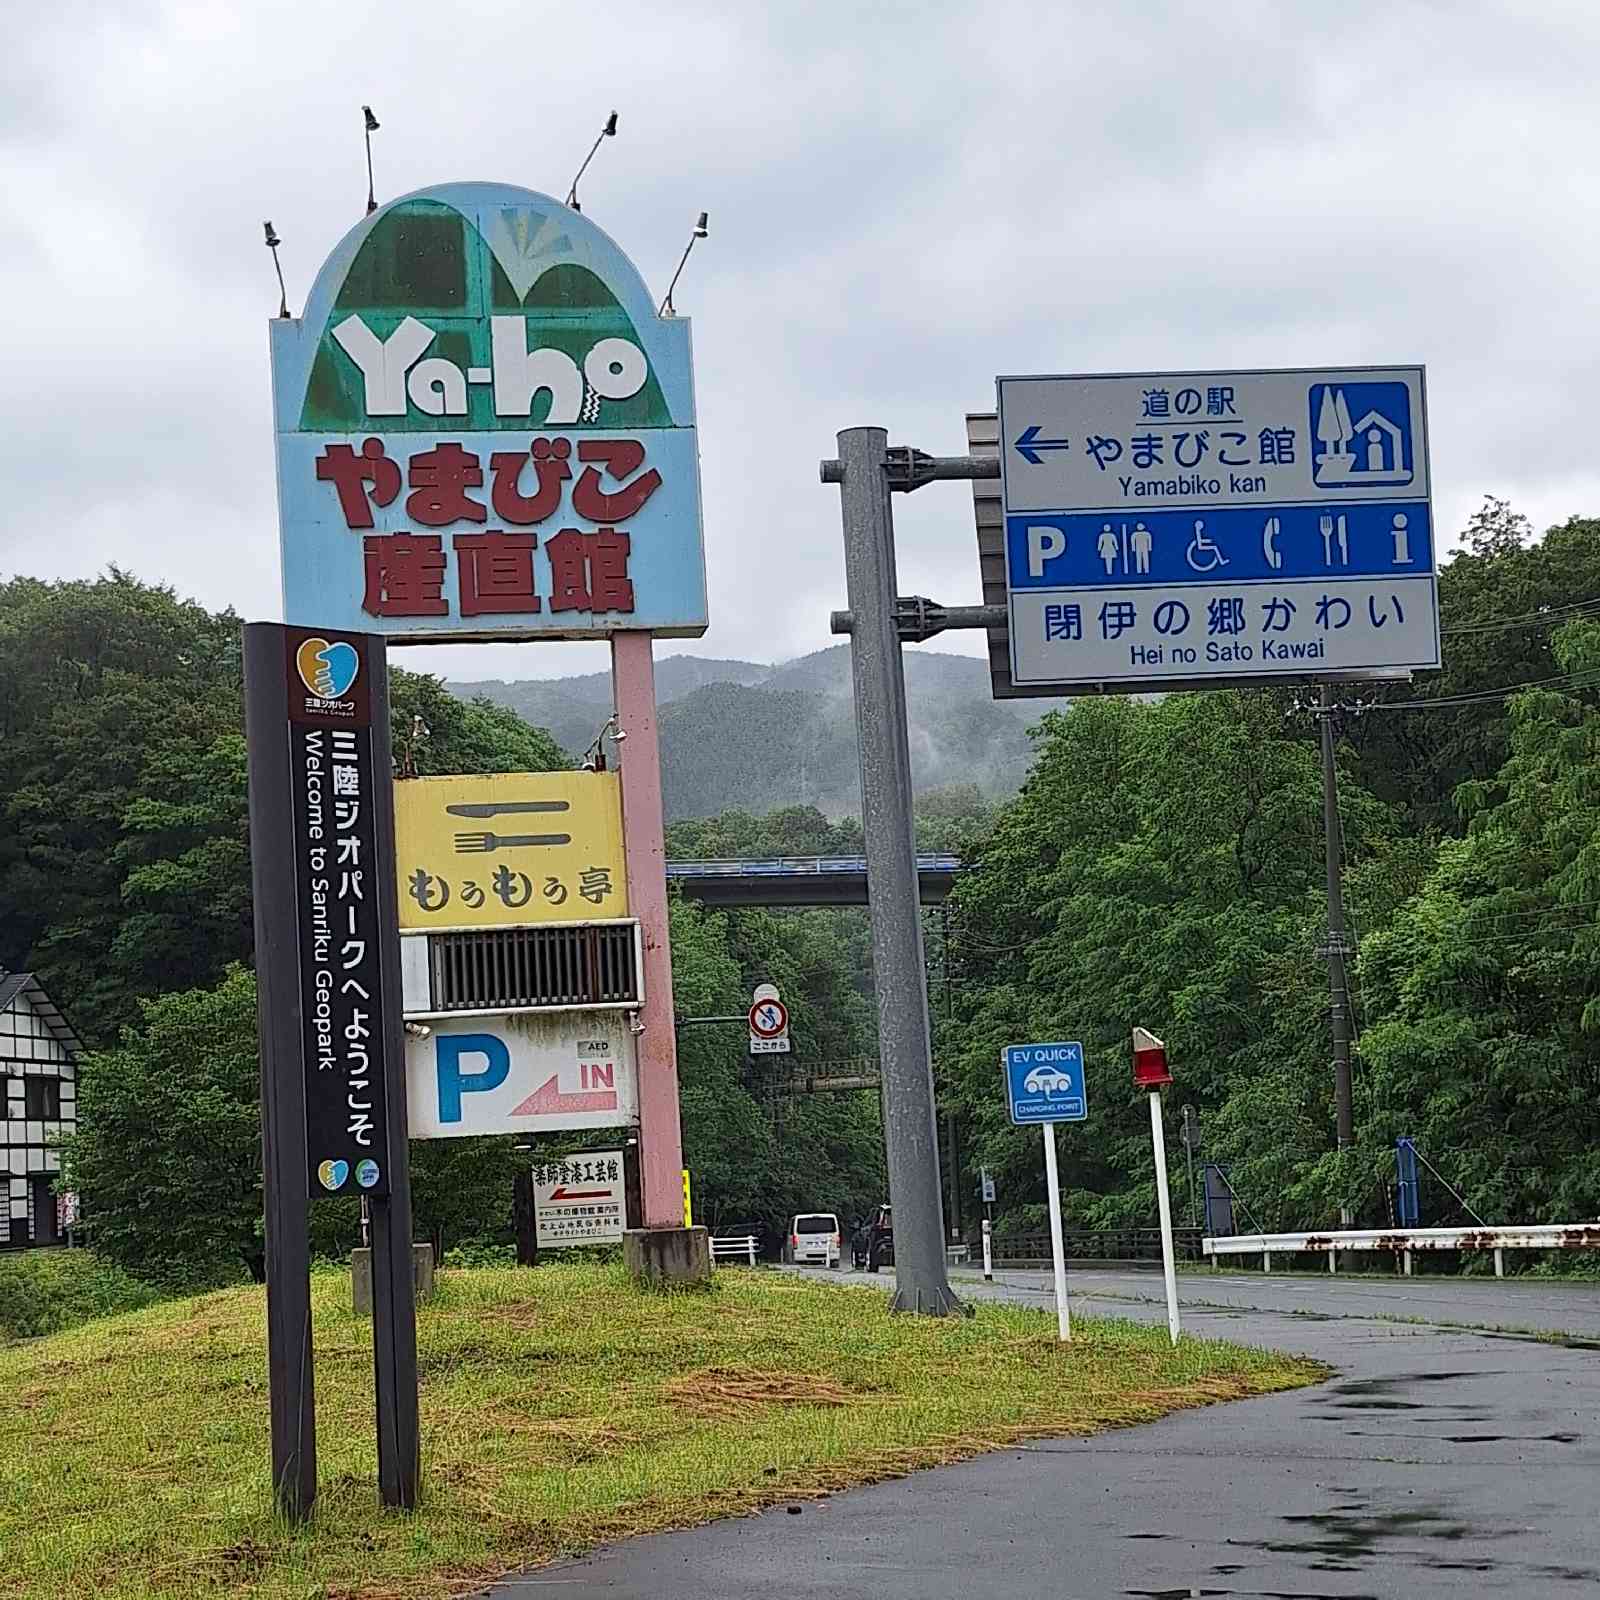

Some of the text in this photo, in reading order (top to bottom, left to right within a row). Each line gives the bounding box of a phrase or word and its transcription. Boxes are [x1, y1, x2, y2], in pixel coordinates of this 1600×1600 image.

[330, 313, 648, 424] Ya-ho
[1141, 386, 1236, 418] 道の駅
[1085, 427, 1296, 470] やまびこ館
[315, 437, 662, 528] やまびこ
[1118, 473, 1266, 497] Yamabiko kan
[361, 528, 635, 617] 産直館
[1044, 593, 1405, 642] 閉伊の郷かわい
[1130, 638, 1325, 665] Hei no Sato Kawai
[304, 730, 337, 1071] Welcome to Sanriku Geopark
[331, 730, 374, 1146] 三陸ジオパークへようこそ
[588, 1041, 609, 1051] AED
[1013, 1048, 1077, 1063] EV QUICK
[580, 1063, 615, 1089] IN
